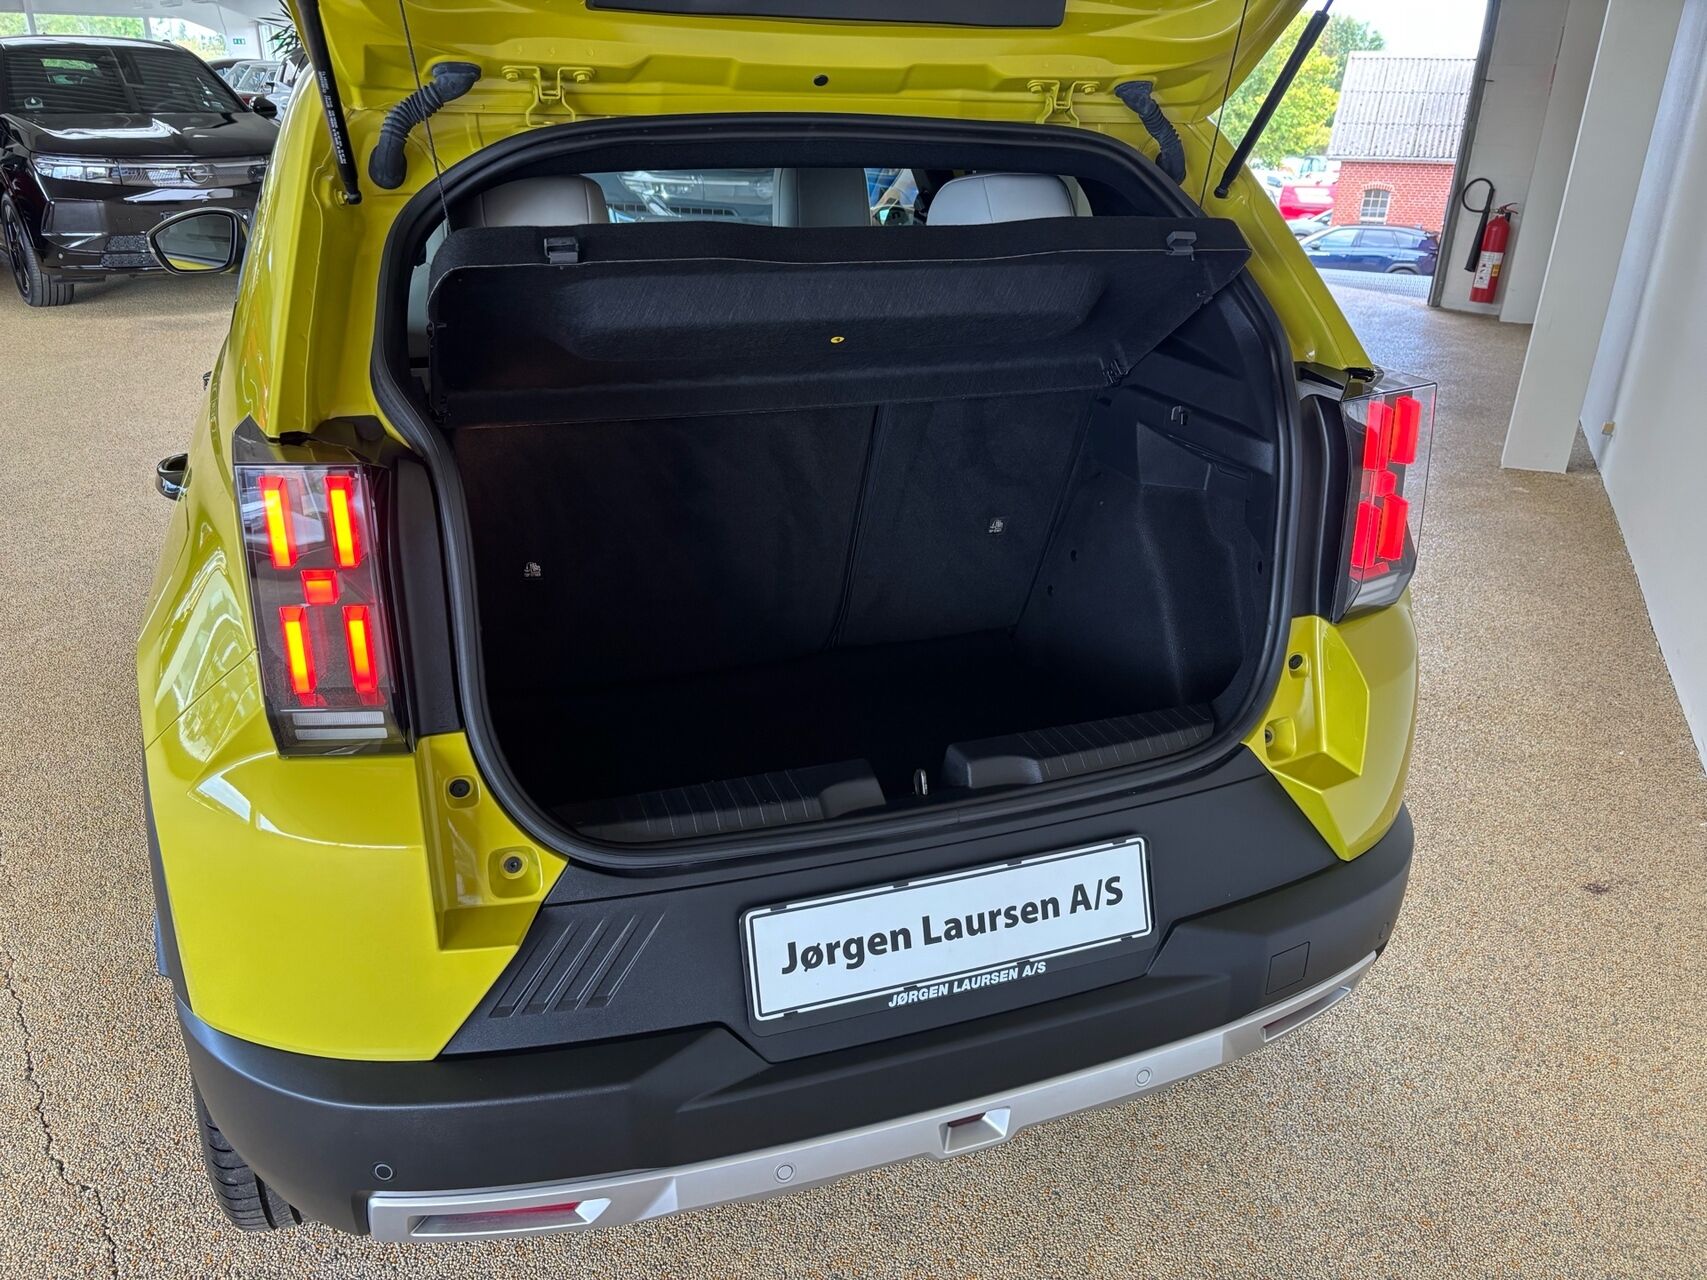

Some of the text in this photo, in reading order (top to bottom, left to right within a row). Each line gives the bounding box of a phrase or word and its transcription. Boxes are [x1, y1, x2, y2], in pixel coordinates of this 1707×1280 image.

[782, 876, 1123, 974] Jørgen Laursen A/S
[888, 962, 1047, 1008] JØRGEN LAURSEN A/S
